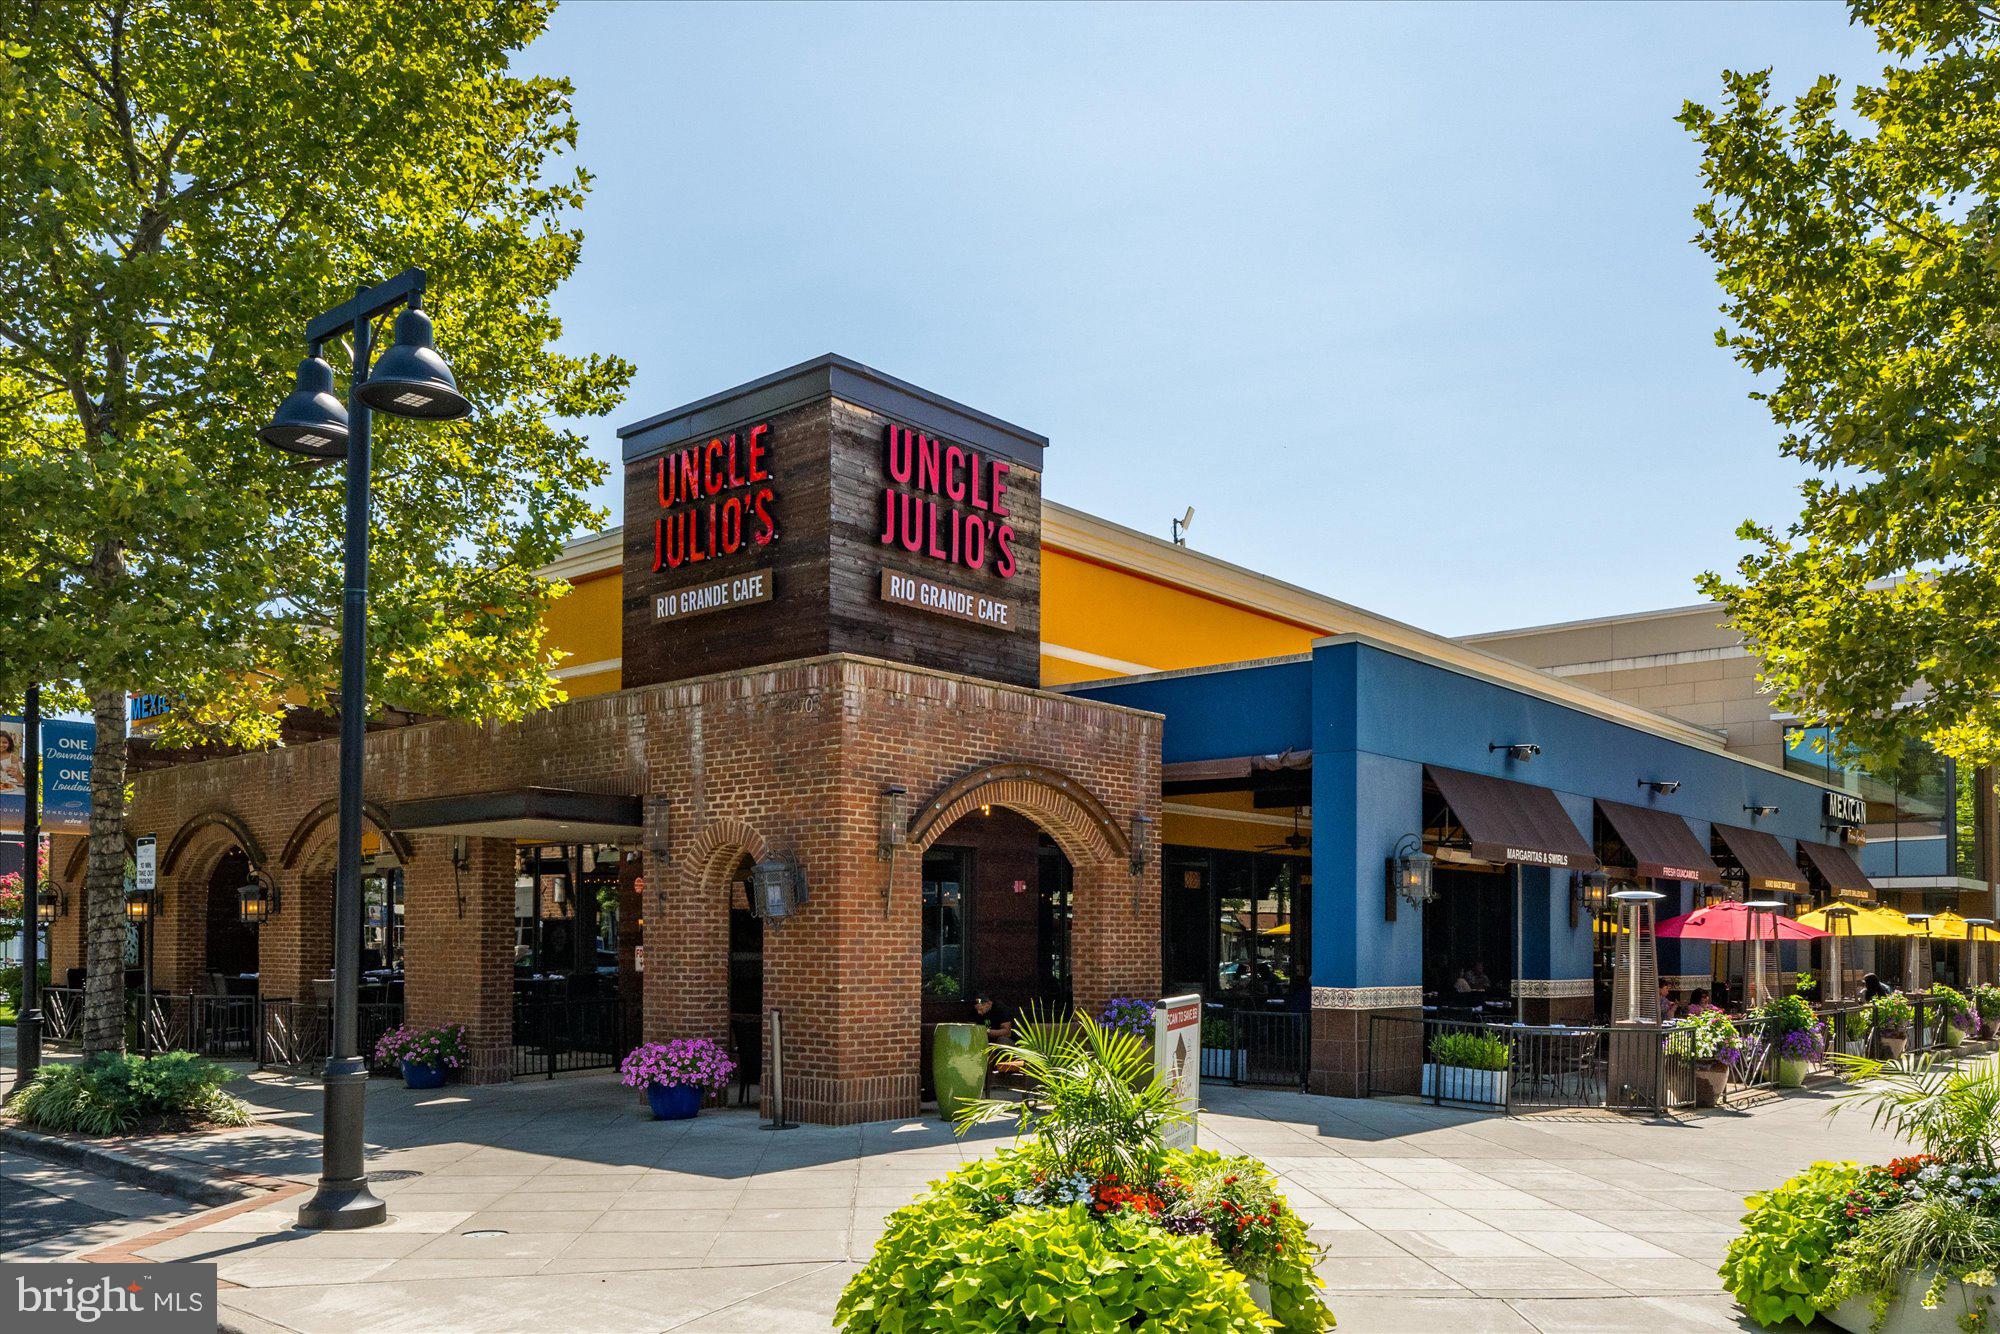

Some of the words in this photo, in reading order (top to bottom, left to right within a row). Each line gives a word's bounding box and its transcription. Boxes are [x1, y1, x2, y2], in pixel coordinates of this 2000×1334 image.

[658, 423, 768, 508] UNCLE
[890, 424, 1010, 517] UNCLE
[652, 488, 774, 573] JULIO'S
[881, 488, 1016, 578] JULIO'S
[656, 596, 677, 618] RIO
[680, 583, 729, 613] GRANDE
[732, 575, 764, 602] CAFE
[890, 575, 916, 601] RIO
[920, 583, 974, 616] GRANDE
[978, 598, 1008, 625] CAFE
[46, 747, 93, 761] Downtow
[52, 780, 91, 792] Loudou
[60, 769, 88, 781] ONE
[1829, 792, 1867, 824] MEXICAN
[1507, 848, 1543, 863] MARGARITAS
[1543, 853, 1548, 863] &
[1548, 853, 1568, 866] SWIRLS
[1663, 867, 1676, 877] FRESH
[1167, 1013, 1178, 1026] SCAN
[1178, 1011, 1184, 1022] TO
